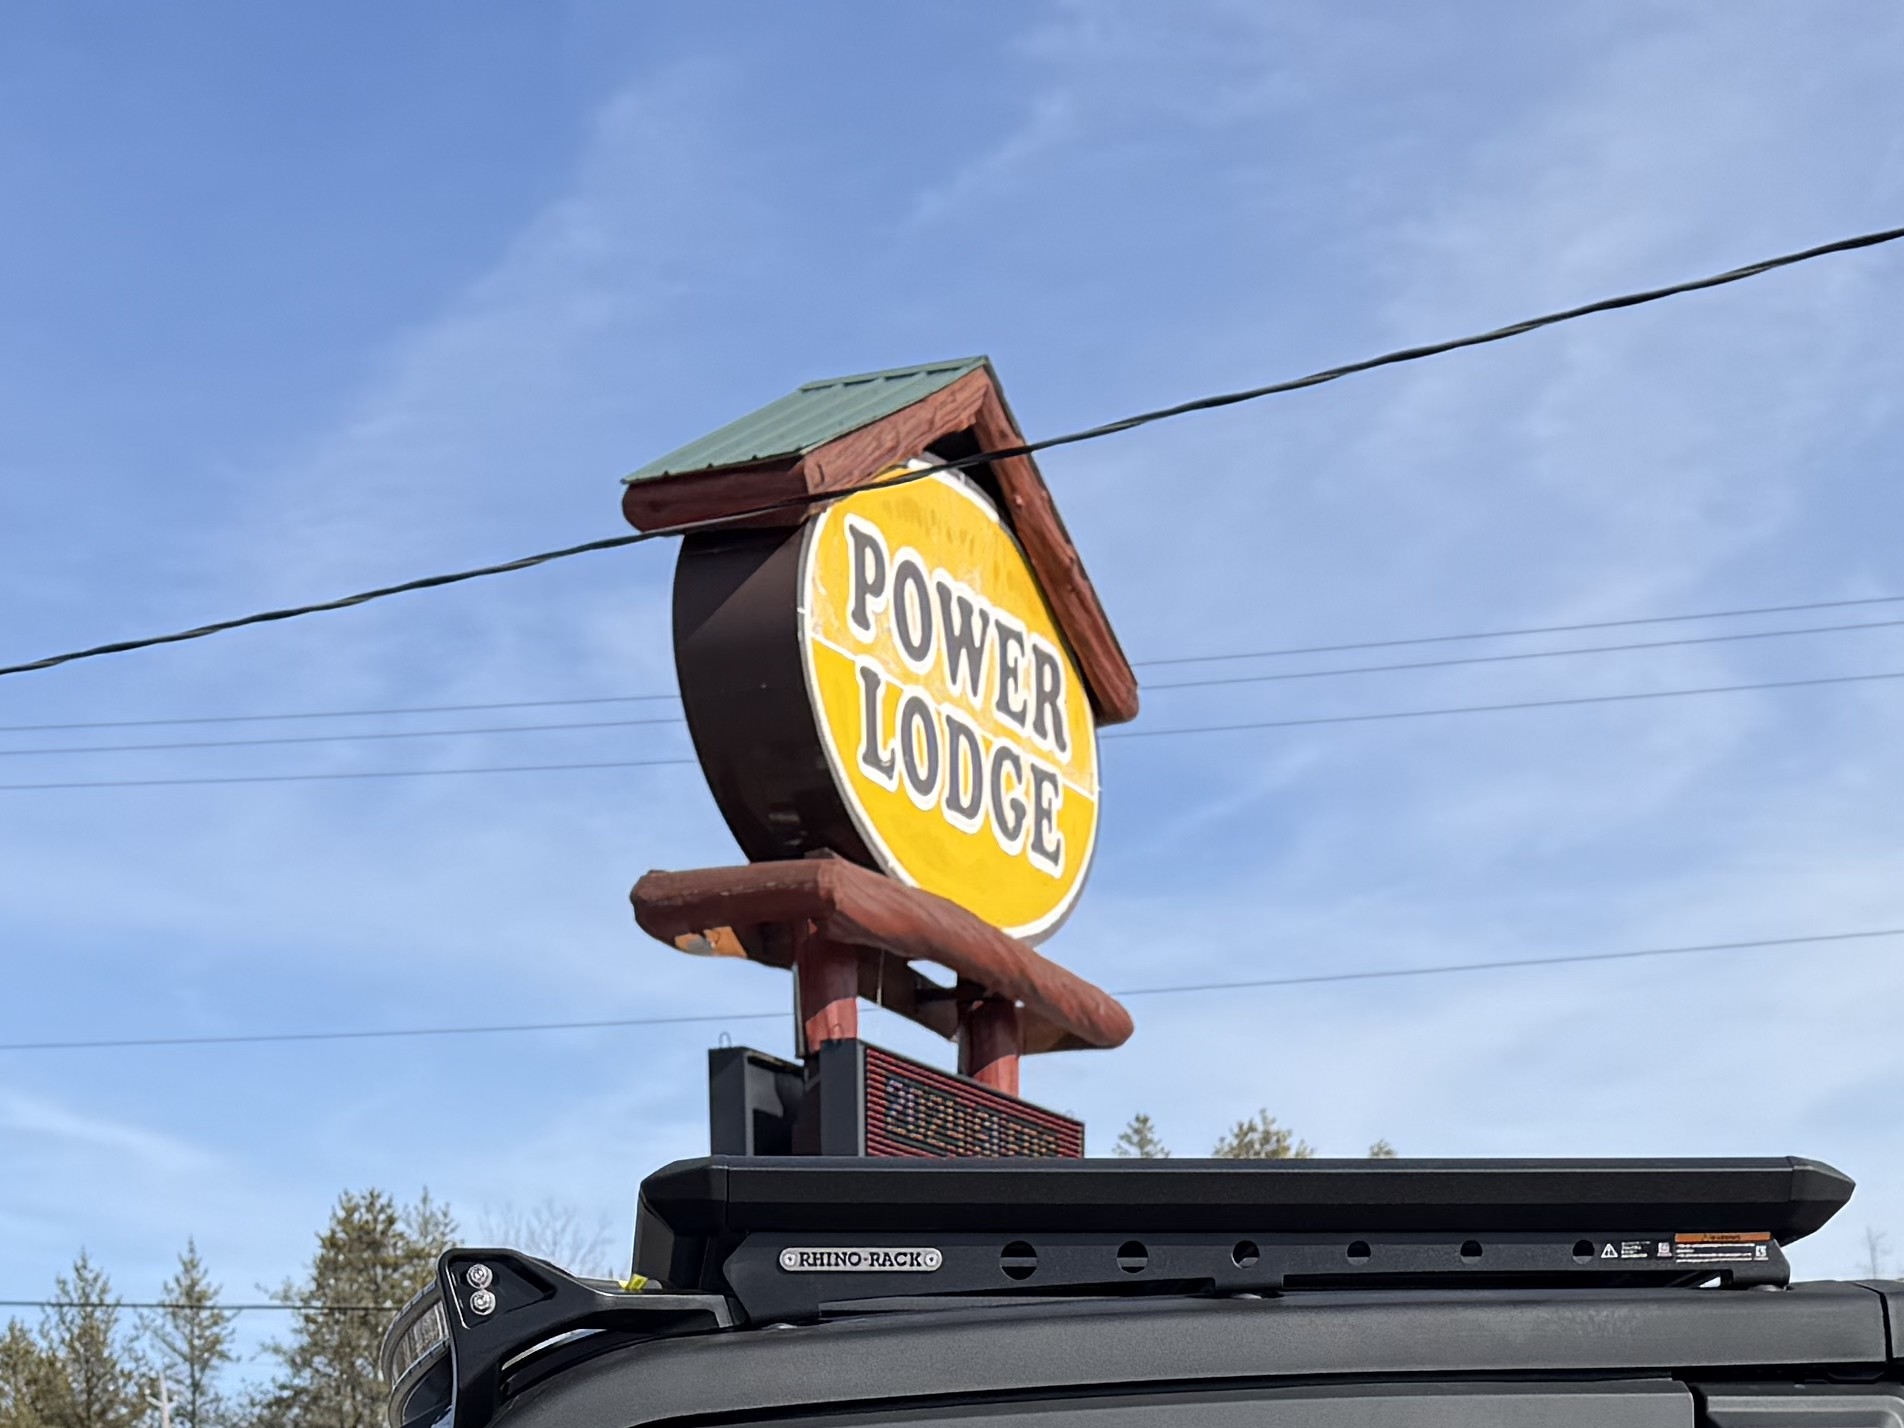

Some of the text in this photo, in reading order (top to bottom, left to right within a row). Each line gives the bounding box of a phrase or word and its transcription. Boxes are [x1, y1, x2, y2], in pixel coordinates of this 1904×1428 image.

[849, 523, 1068, 753] POWER
[859, 665, 1064, 867] LODGE
[798, 1251, 922, 1268] RHINO-RACK
